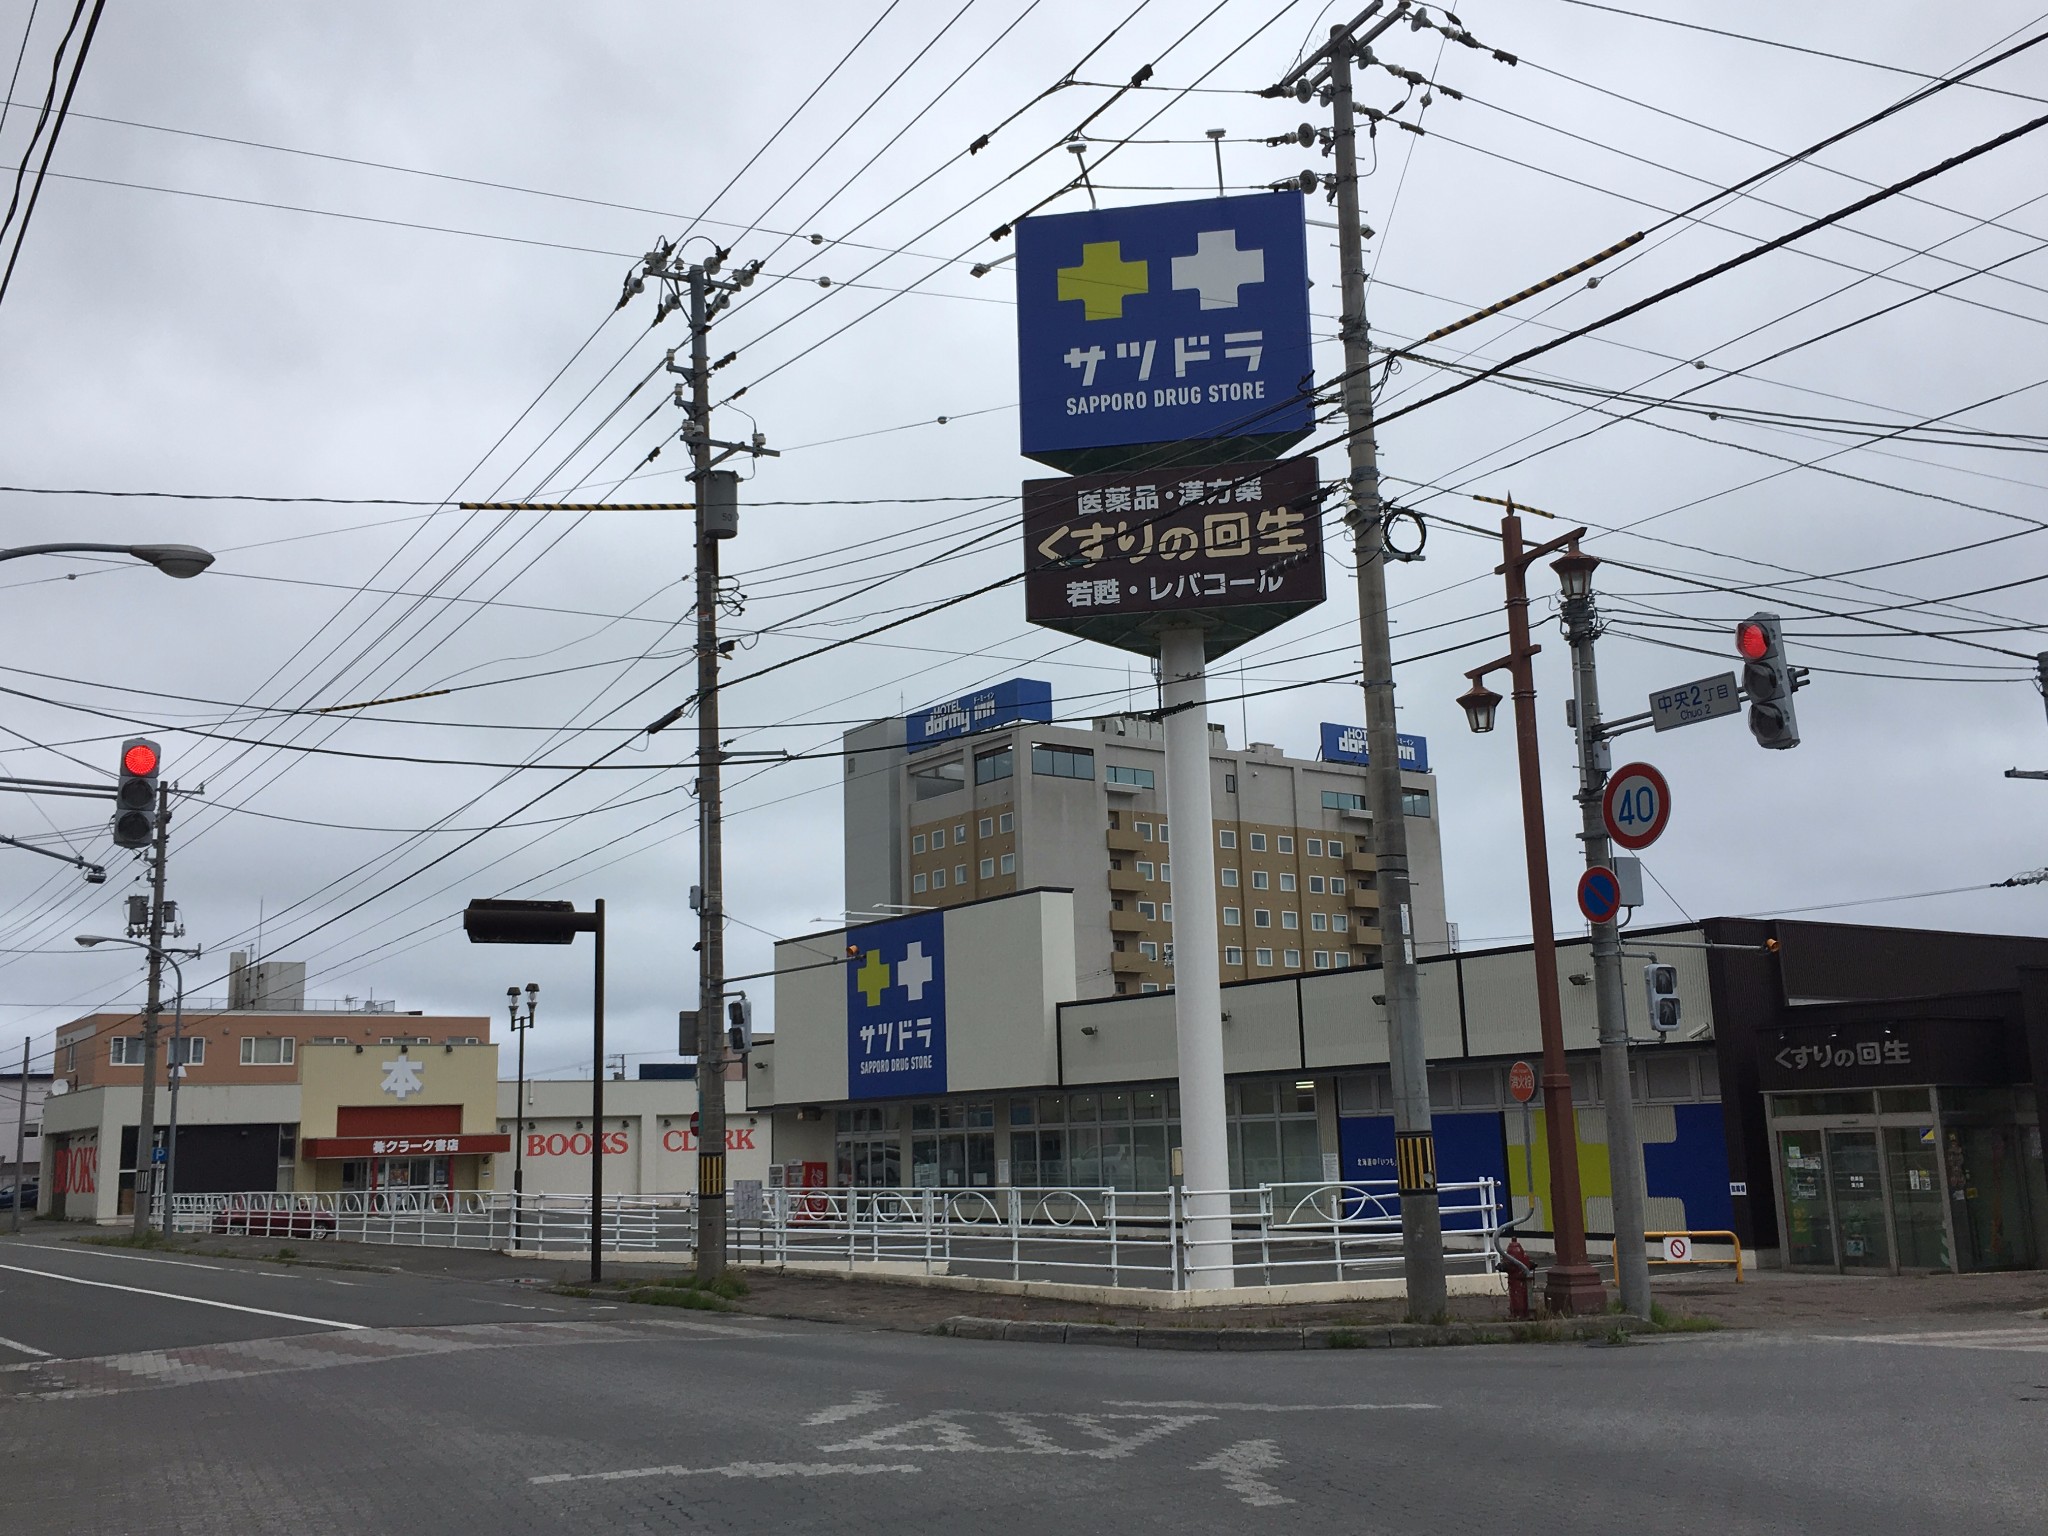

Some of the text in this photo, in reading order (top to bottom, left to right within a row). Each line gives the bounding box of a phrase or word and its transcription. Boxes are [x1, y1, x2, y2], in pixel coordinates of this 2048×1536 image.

[1063, 330, 1263, 387] サツドラ
[1066, 380, 1266, 416] SAPPORO DRUG STORE
[1077, 475, 1263, 516] 医薬品・漢方薬
[1037, 505, 1309, 570] くすりの回生
[933, 699, 961, 720] HOTEL
[1657, 684, 1729, 714] 中央2丁目
[1680, 704, 1712, 721] Chuo 2
[925, 699, 996, 737] dormy inn
[1347, 727, 1369, 741] HOT
[1618, 786, 1654, 825] 40
[859, 1017, 932, 1054] サツドラ
[860, 1055, 933, 1074] SAPPORO DRUG STORE
[1775, 1039, 1912, 1070] くすりの回生
[379, 1055, 424, 1099] 本
[155, 1149, 165, 1160] P
[662, 1128, 756, 1153] CLRK
